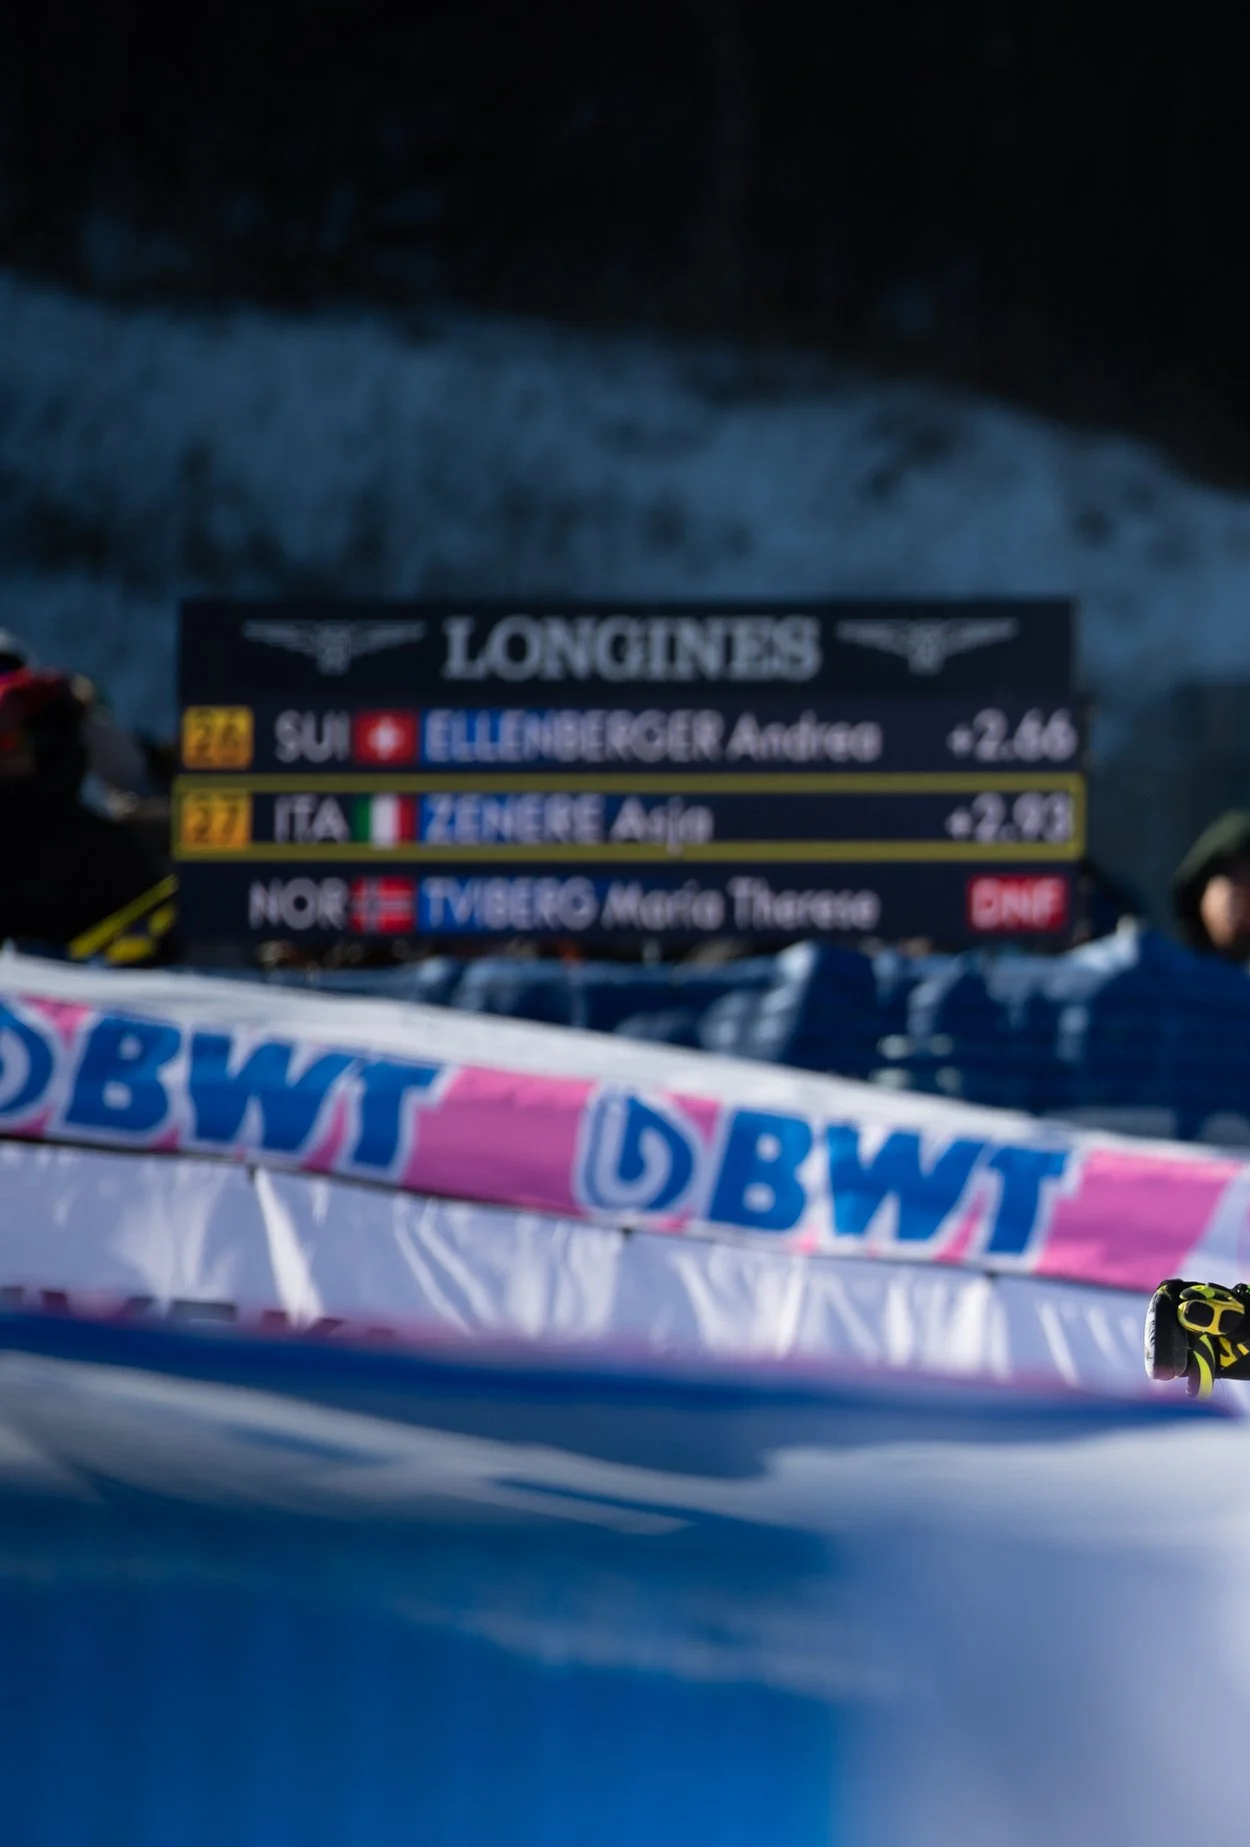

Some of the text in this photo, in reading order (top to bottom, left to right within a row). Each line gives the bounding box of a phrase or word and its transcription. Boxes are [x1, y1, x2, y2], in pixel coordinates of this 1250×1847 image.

[443, 615, 822, 681] LONGINES
[274, 709, 350, 763] SUI
[425, 709, 725, 763] ELLENBERGER
[727, 709, 883, 763] Andrea
[946, 708, 1078, 763] +2.66
[274, 793, 350, 845] ITA
[422, 793, 601, 846] ZENERE
[610, 795, 714, 857] Asja
[945, 792, 1074, 844] +2.93
[249, 877, 351, 930] NOR
[422, 876, 598, 930] TVIBERG
[602, 879, 726, 931] Maria
[969, 877, 1068, 930] DNF
[65, 1009, 443, 1170] BWT
[709, 1107, 1069, 1255] BWT
